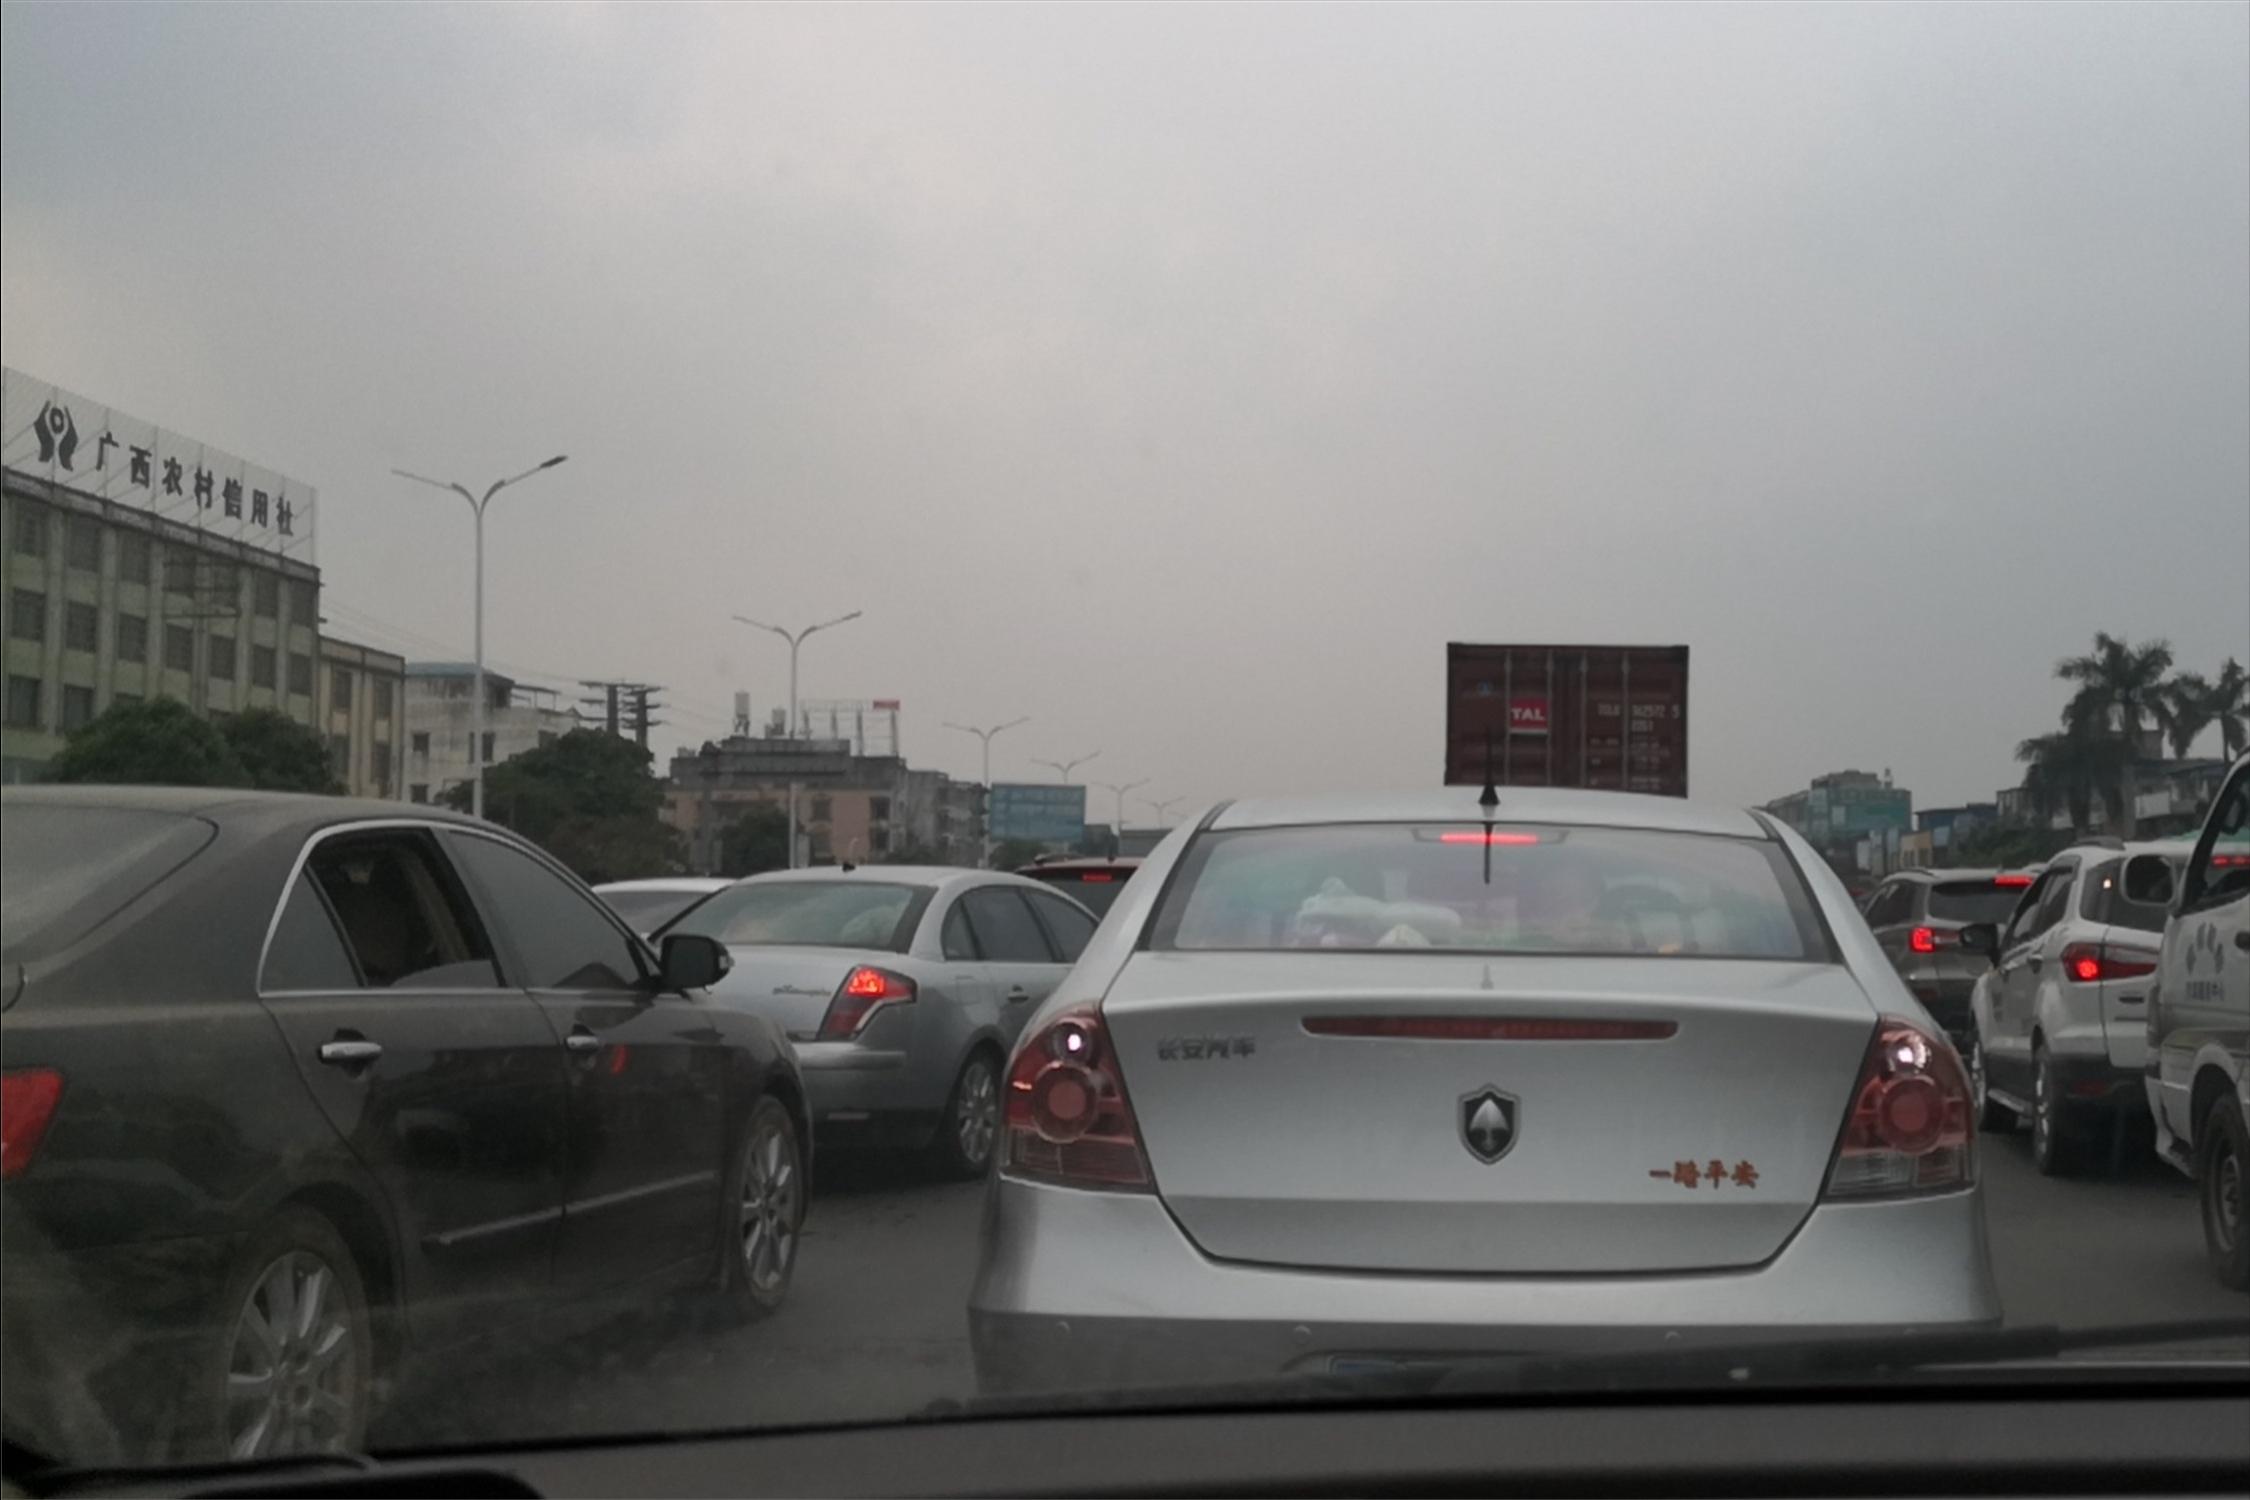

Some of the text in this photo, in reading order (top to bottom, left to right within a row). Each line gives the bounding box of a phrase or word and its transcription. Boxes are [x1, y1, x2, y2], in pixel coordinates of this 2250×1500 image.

[96, 431, 294, 537] 广西农村信用社
[1511, 707, 1545, 721] TAL
[1157, 1034, 1257, 1061] 长安汽车
[1648, 1159, 1760, 1189] 一路平安
